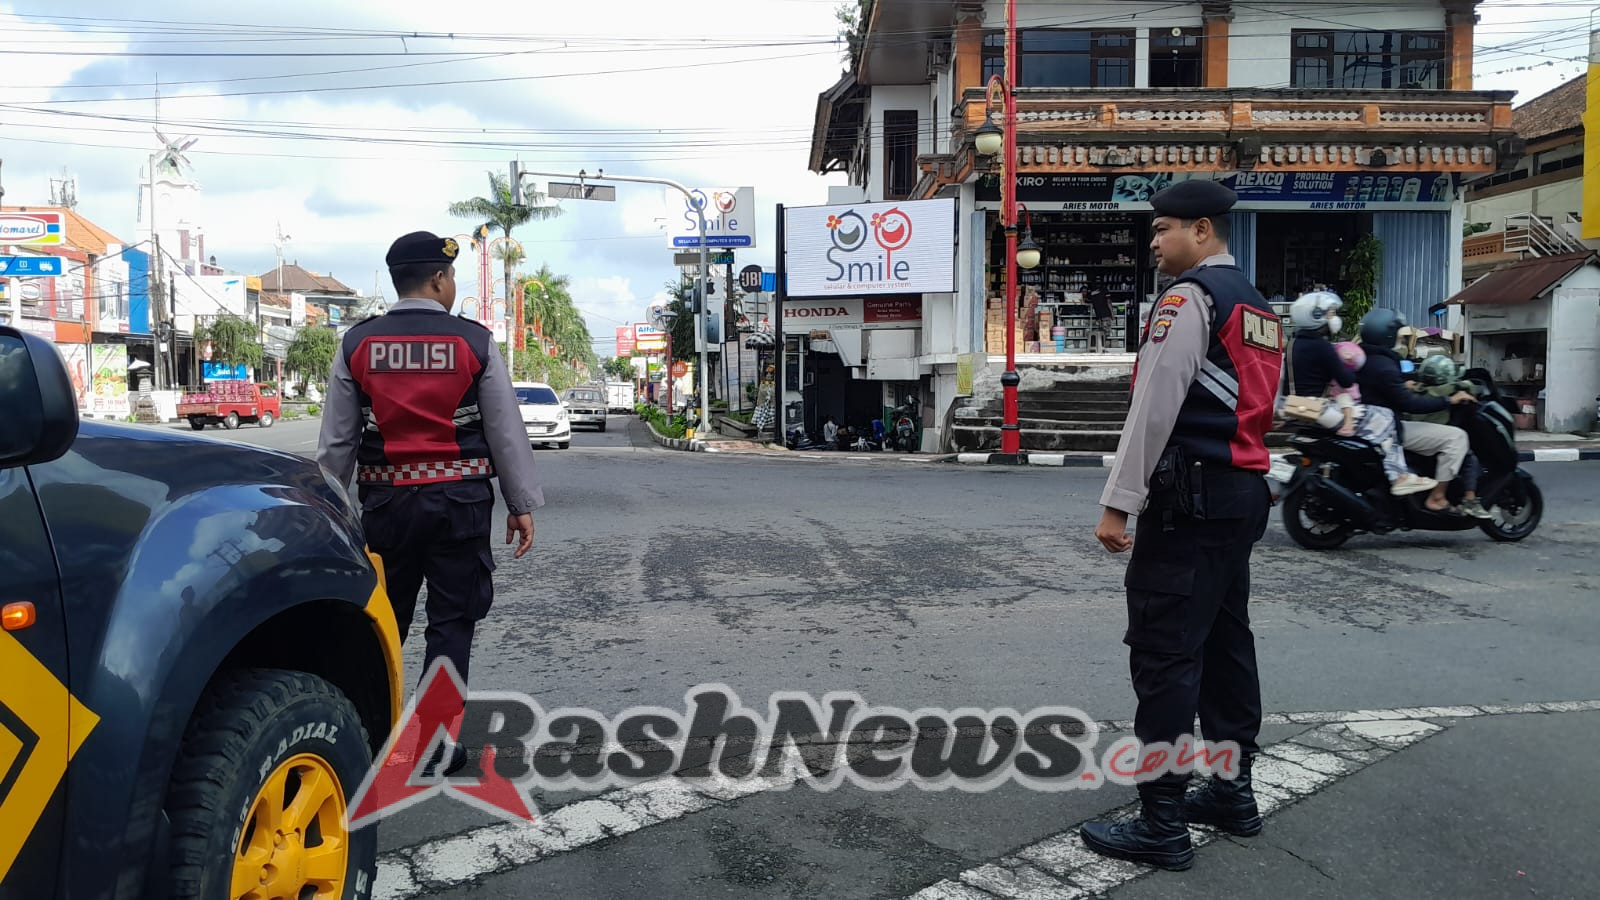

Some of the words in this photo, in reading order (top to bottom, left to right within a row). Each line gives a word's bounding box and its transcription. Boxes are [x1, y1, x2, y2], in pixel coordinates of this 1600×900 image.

[1234, 172, 1284, 185] REXCO
[1295, 172, 1335, 181] PROVABLE
[1293, 180, 1333, 189] SOLUTION
[1063, 202, 1087, 210] ARIES
[1091, 202, 1119, 210] MOTOR
[826, 246, 910, 282] Smile
[784, 307, 850, 318] HONDA
[1243, 310, 1279, 349] POLISI
[370, 342, 455, 370] POLISI
[259, 721, 339, 784] RADIAL
